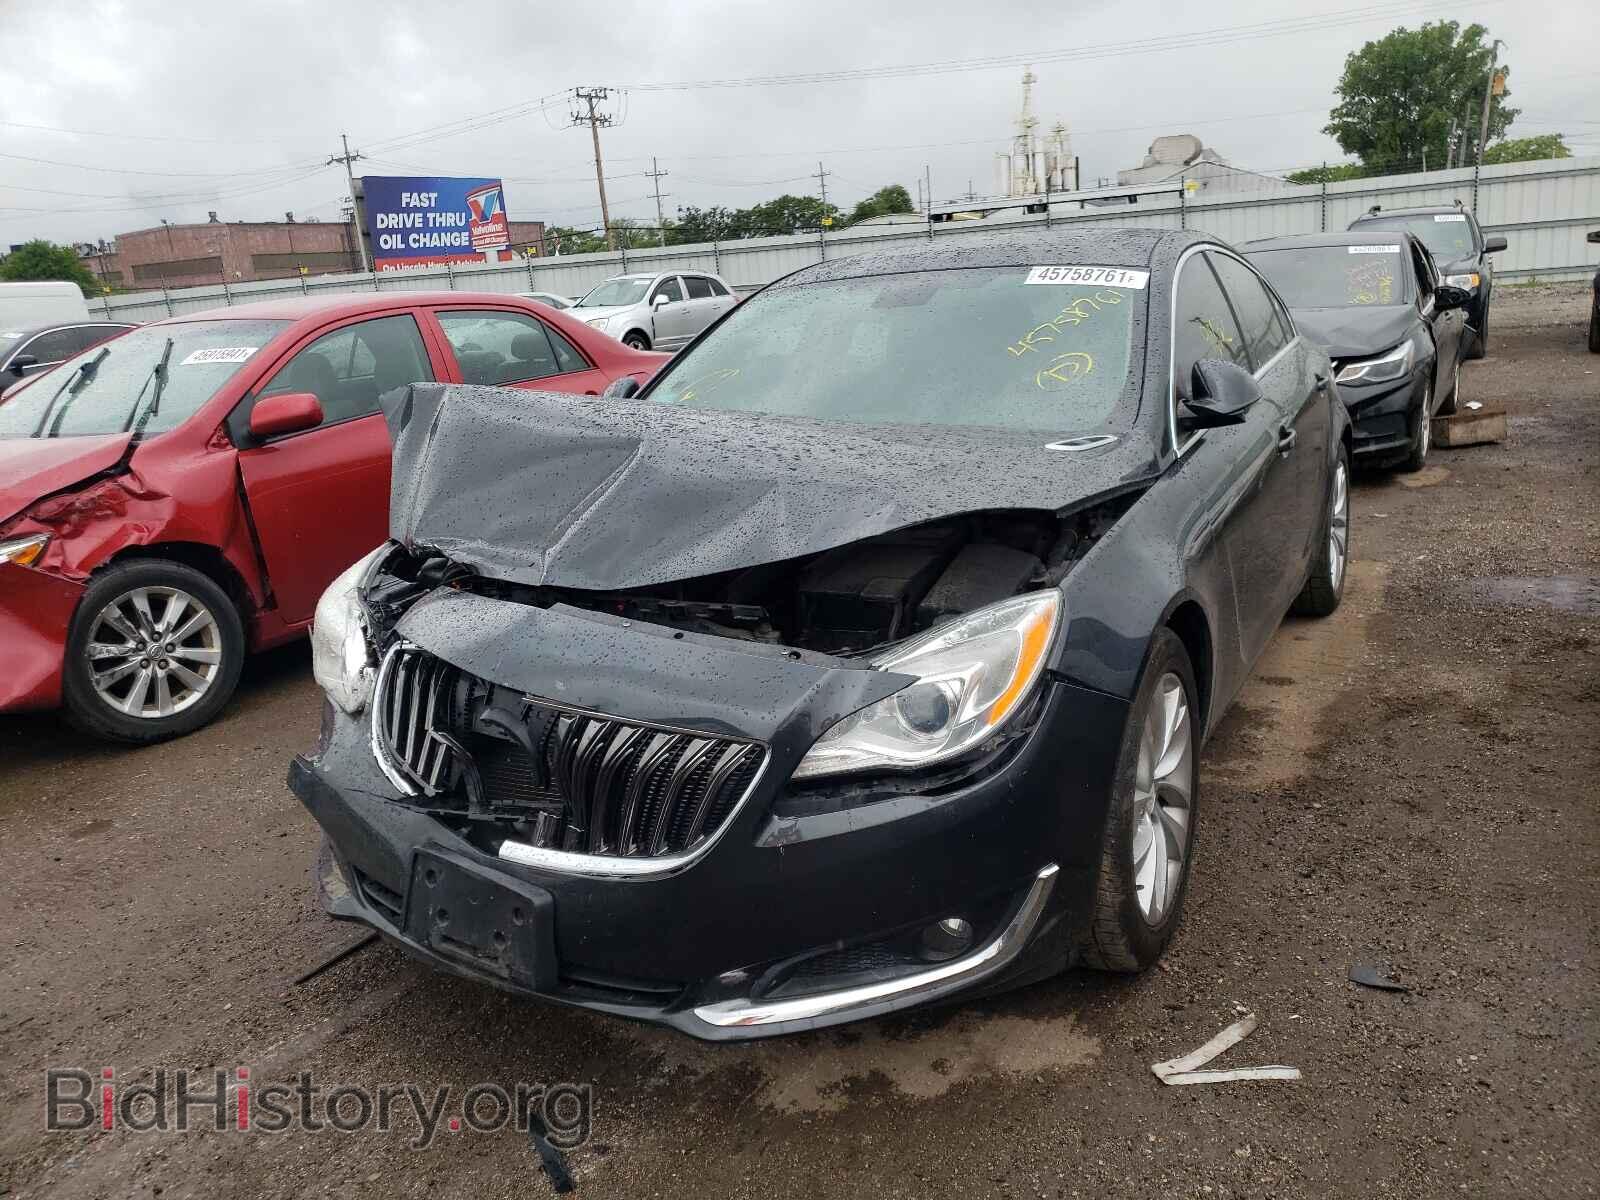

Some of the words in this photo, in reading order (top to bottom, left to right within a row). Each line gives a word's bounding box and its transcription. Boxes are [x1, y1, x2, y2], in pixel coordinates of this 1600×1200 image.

[402, 192, 438, 208] FAST
[376, 213, 423, 229] DRIVE
[427, 212, 466, 228] THRU
[472, 223, 503, 235] Valvoline
[379, 233, 406, 250] OIL
[408, 232, 470, 248] CHANGE
[1038, 267, 1127, 283] 45758761
